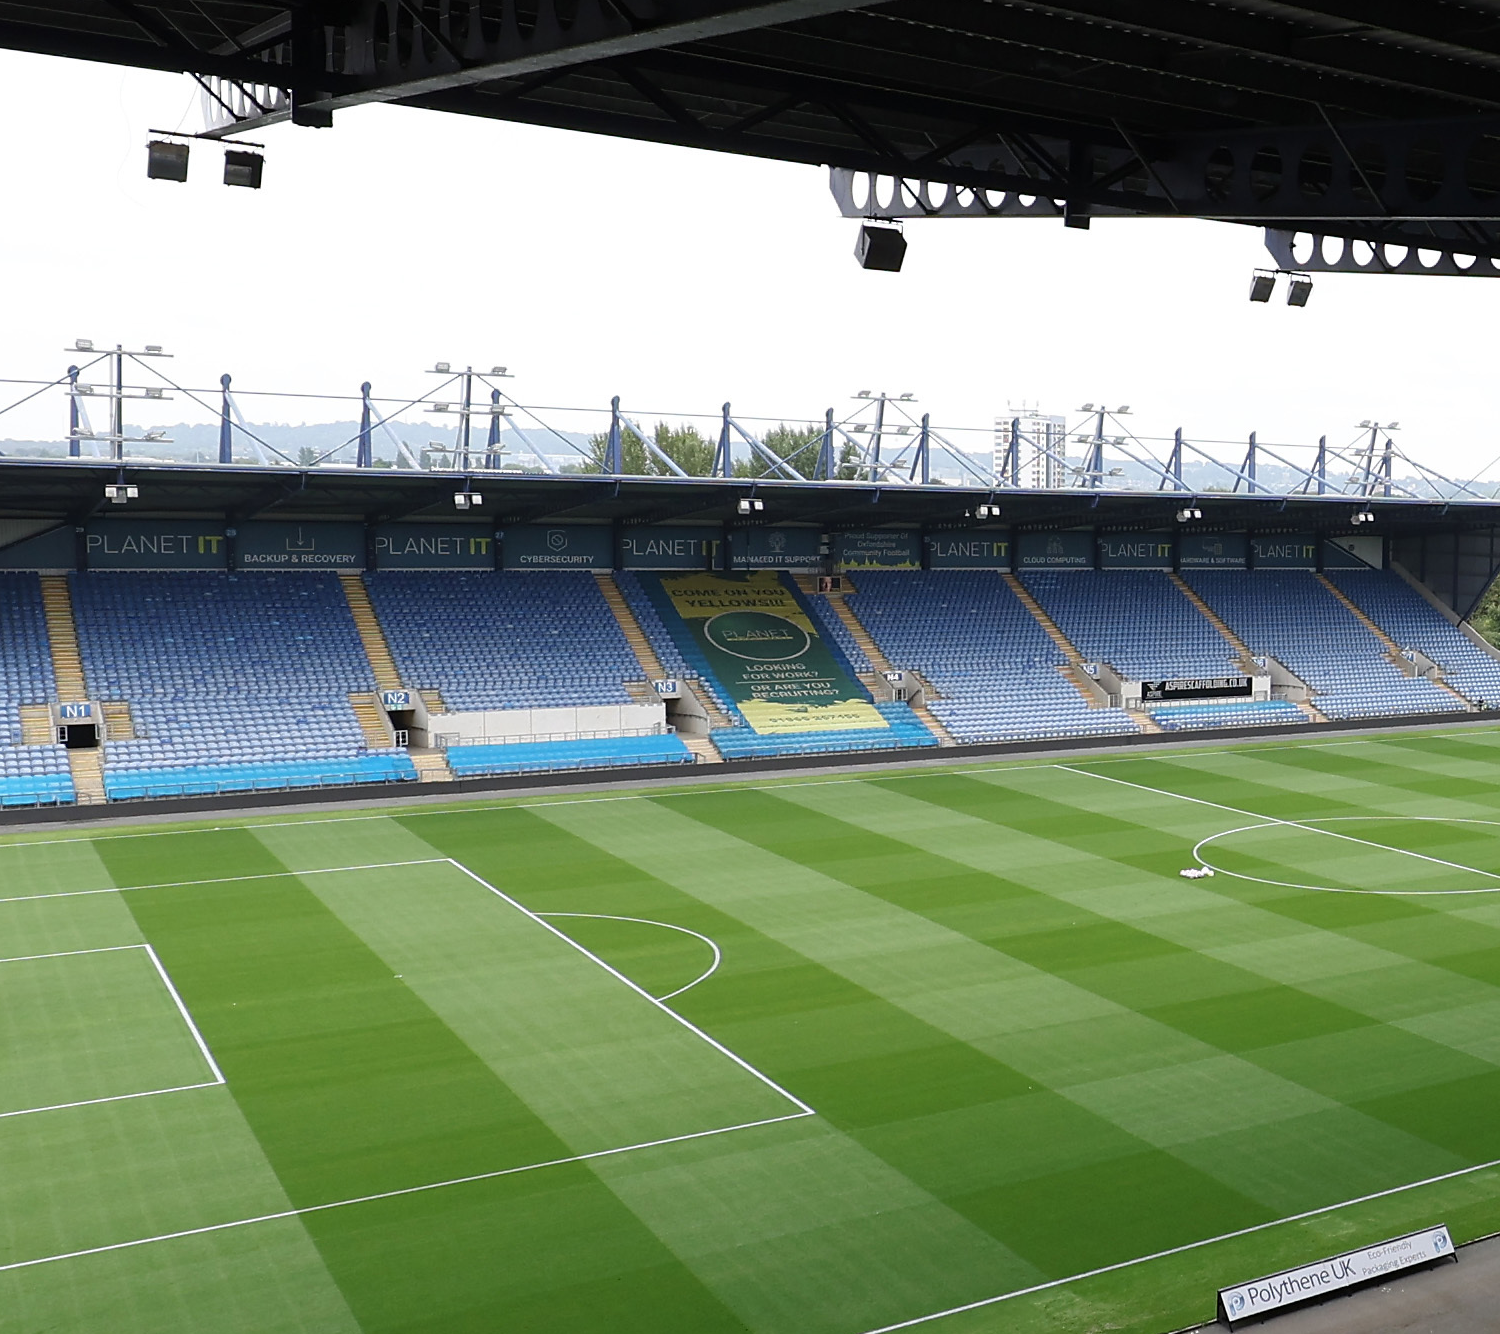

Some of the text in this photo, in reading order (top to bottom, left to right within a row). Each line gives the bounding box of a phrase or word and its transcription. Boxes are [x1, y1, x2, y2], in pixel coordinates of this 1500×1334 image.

[86, 535, 223, 554] PLANET IT
[375, 537, 492, 555] PLANET IT
[622, 538, 697, 556] PLANET
[930, 542, 1008, 557] PLANET IT
[1101, 543, 1172, 557] PLANET IT
[843, 548, 910, 557] Community Football
[1254, 545, 1315, 558] PLANET IT
[244, 554, 356, 563] BACKUP & RECOVERY
[520, 555, 594, 564] CYBERSECURITY
[774, 555, 782, 564] IT
[671, 588, 786, 597] COME ON YOU
[721, 628, 789, 639] PLANET
[746, 663, 806, 672] LOOKING
[742, 671, 819, 681] FOR WORK?
[887, 673, 898, 681] N4
[658, 681, 672, 692] N3
[750, 682, 831, 692] OR ARE YOU
[388, 692, 405, 704] N2
[751, 689, 840, 699] RECRUITING?
[66, 705, 85, 717] N1
[1367, 1240, 1412, 1260] Eco-Friendly
[1362, 1250, 1427, 1276] Packaging Experts
[1247, 1258, 1357, 1307] Polythene UK
